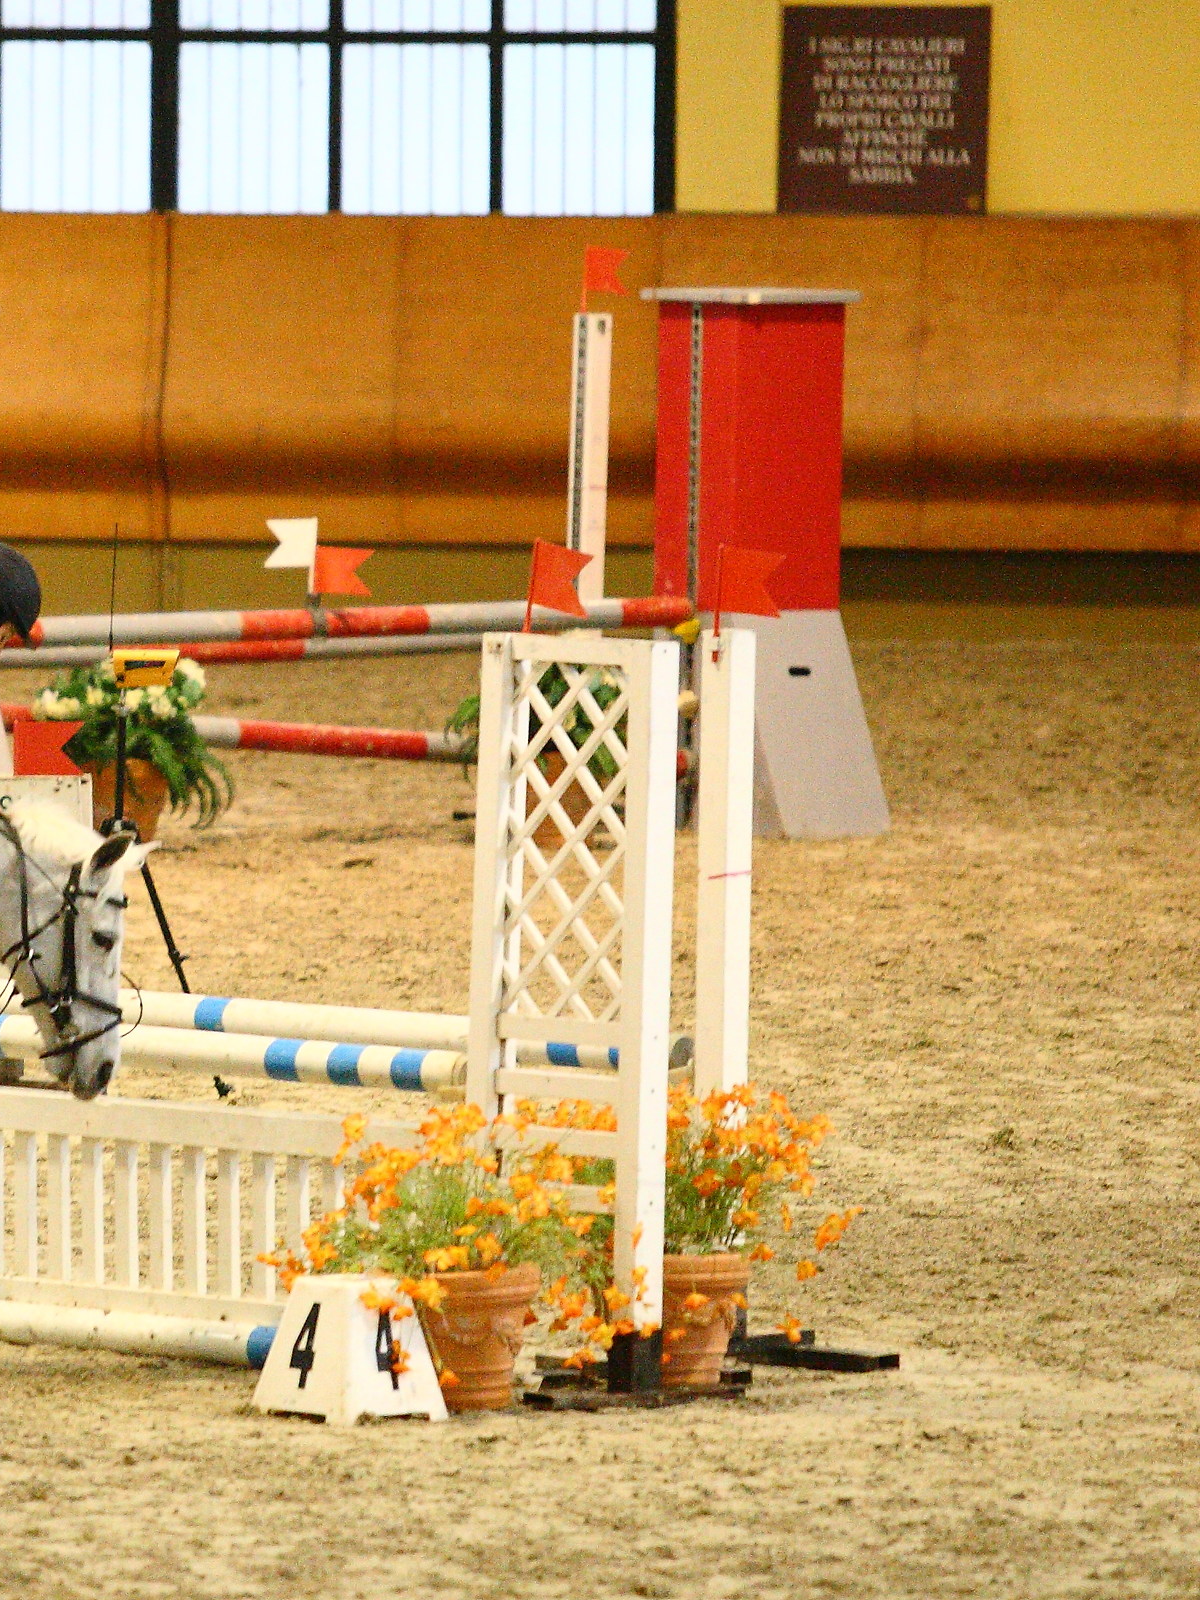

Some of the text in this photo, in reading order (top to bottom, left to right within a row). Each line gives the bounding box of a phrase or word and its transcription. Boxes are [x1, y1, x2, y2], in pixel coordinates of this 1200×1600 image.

[836, 75, 958, 91] RACCOGLIERE
[884, 112, 955, 128] CAVALLI
[798, 148, 835, 164] NON
[926, 149, 970, 165] ALLA
[289, 1302, 321, 1389] 4
[375, 1306, 400, 1390] 4
